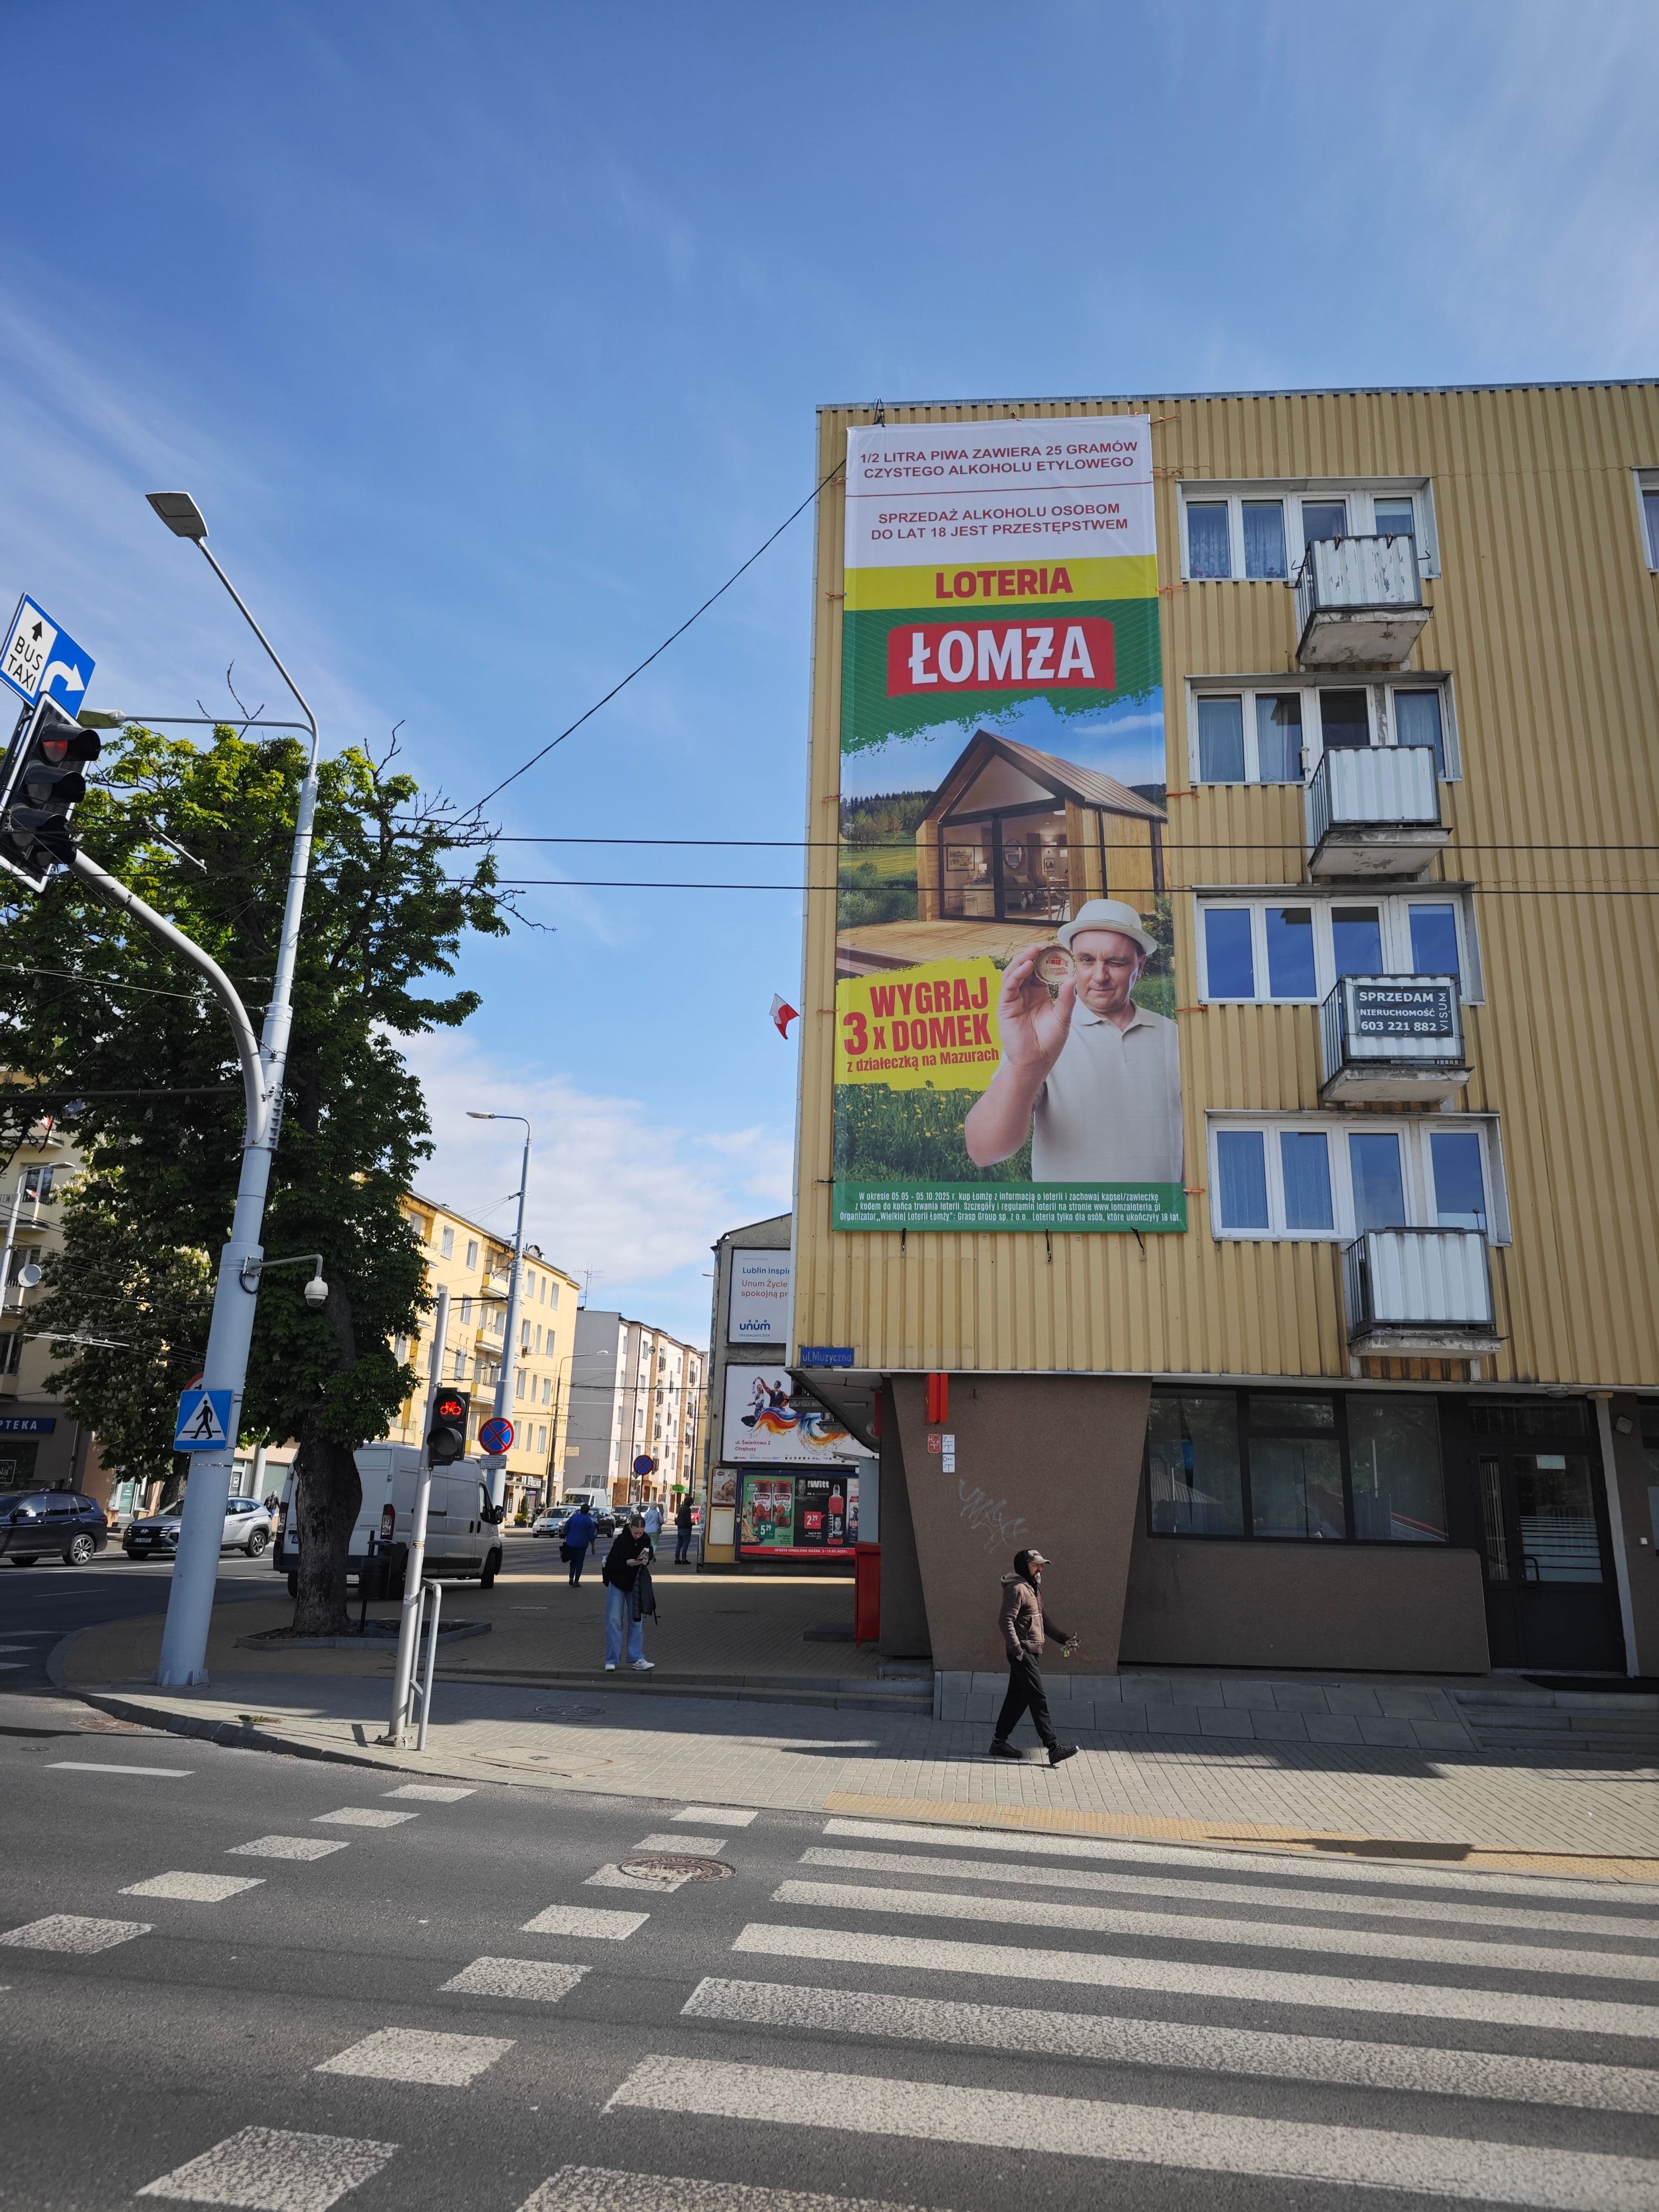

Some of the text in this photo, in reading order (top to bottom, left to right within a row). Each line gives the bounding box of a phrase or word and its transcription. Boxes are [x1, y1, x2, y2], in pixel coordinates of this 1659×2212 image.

[860, 440, 1137, 463] 1/2 LITRA PIWA ZAWIERA 25 GRAMÓW
[864, 457, 1134, 478] CZYSTEGO ALKOHOLU ETYLOWEGO
[879, 503, 1120, 524] SPRZEDAŻ ALKOHOLU OSOBOM
[872, 519, 1128, 539] DO LAT 18 JEST PRZESTĘPSTWEM
[936, 567, 1073, 598] LOTERIA
[15, 636, 43, 670] BUS
[908, 626, 1095, 684] ŁOMŻA
[8, 653, 36, 691] TAXI
[869, 977, 988, 1017] WYGRAJ
[1359, 992, 1434, 1002] SPRZEDAM
[1360, 1008, 1435, 1017] NIERUCHOMOŚĆ
[1438, 993, 1448, 1031] VISUM
[843, 1011, 868, 1055] 3
[892, 1013, 992, 1052] DOMEK
[1361, 1021, 1437, 1031] 603 221 882
[847, 1048, 999, 1073] z działeczką na Mazurach
[860, 1202, 881, 1210] kodem
[883, 1202, 891, 1210] do
[893, 1202, 912, 1210] końca
[914, 1202, 938, 1210] trwania
[940, 1202, 961, 1210] loterii.
[964, 1201, 995, 1211] Szczegóły
[997, 1202, 999, 1210] i
[1001, 1202, 1035, 1211] regulamin
[1036, 1203, 1056, 1211] loterii
[1069, 1203, 1091, 1211] stronie
[867, 1192, 889, 1200] okresie
[916, 1192, 950, 1201] 05.10.2025
[959, 1192, 970, 1201] kup
[1000, 1192, 1035, 1203] informacją
[1043, 1192, 1063, 1201] loterii
[1069, 1192, 1100, 1202] zachowaj
[908, 1212, 928, 1220] Loterii
[957, 1212, 975, 1221] Grasp
[977, 1212, 996, 1221] Group
[999, 1213, 1008, 1221] sp.
[1032, 1212, 1055, 1221] Loteria
[1057, 1212, 1073, 1222] tylko
[1075, 1213, 1085, 1221] dla
[1087, 1213, 1105, 1222] osób,
[1107, 1213, 1124, 1221] które
[1126, 1213, 1159, 1222] ukończyły
[1161, 1213, 1168, 1221] 18
[1170, 1213, 1181, 1221] lat.
[741, 1290, 778, 1298] spokojną
[766, 1279, 787, 1288] Życie
[739, 1319, 770, 1330] unum
